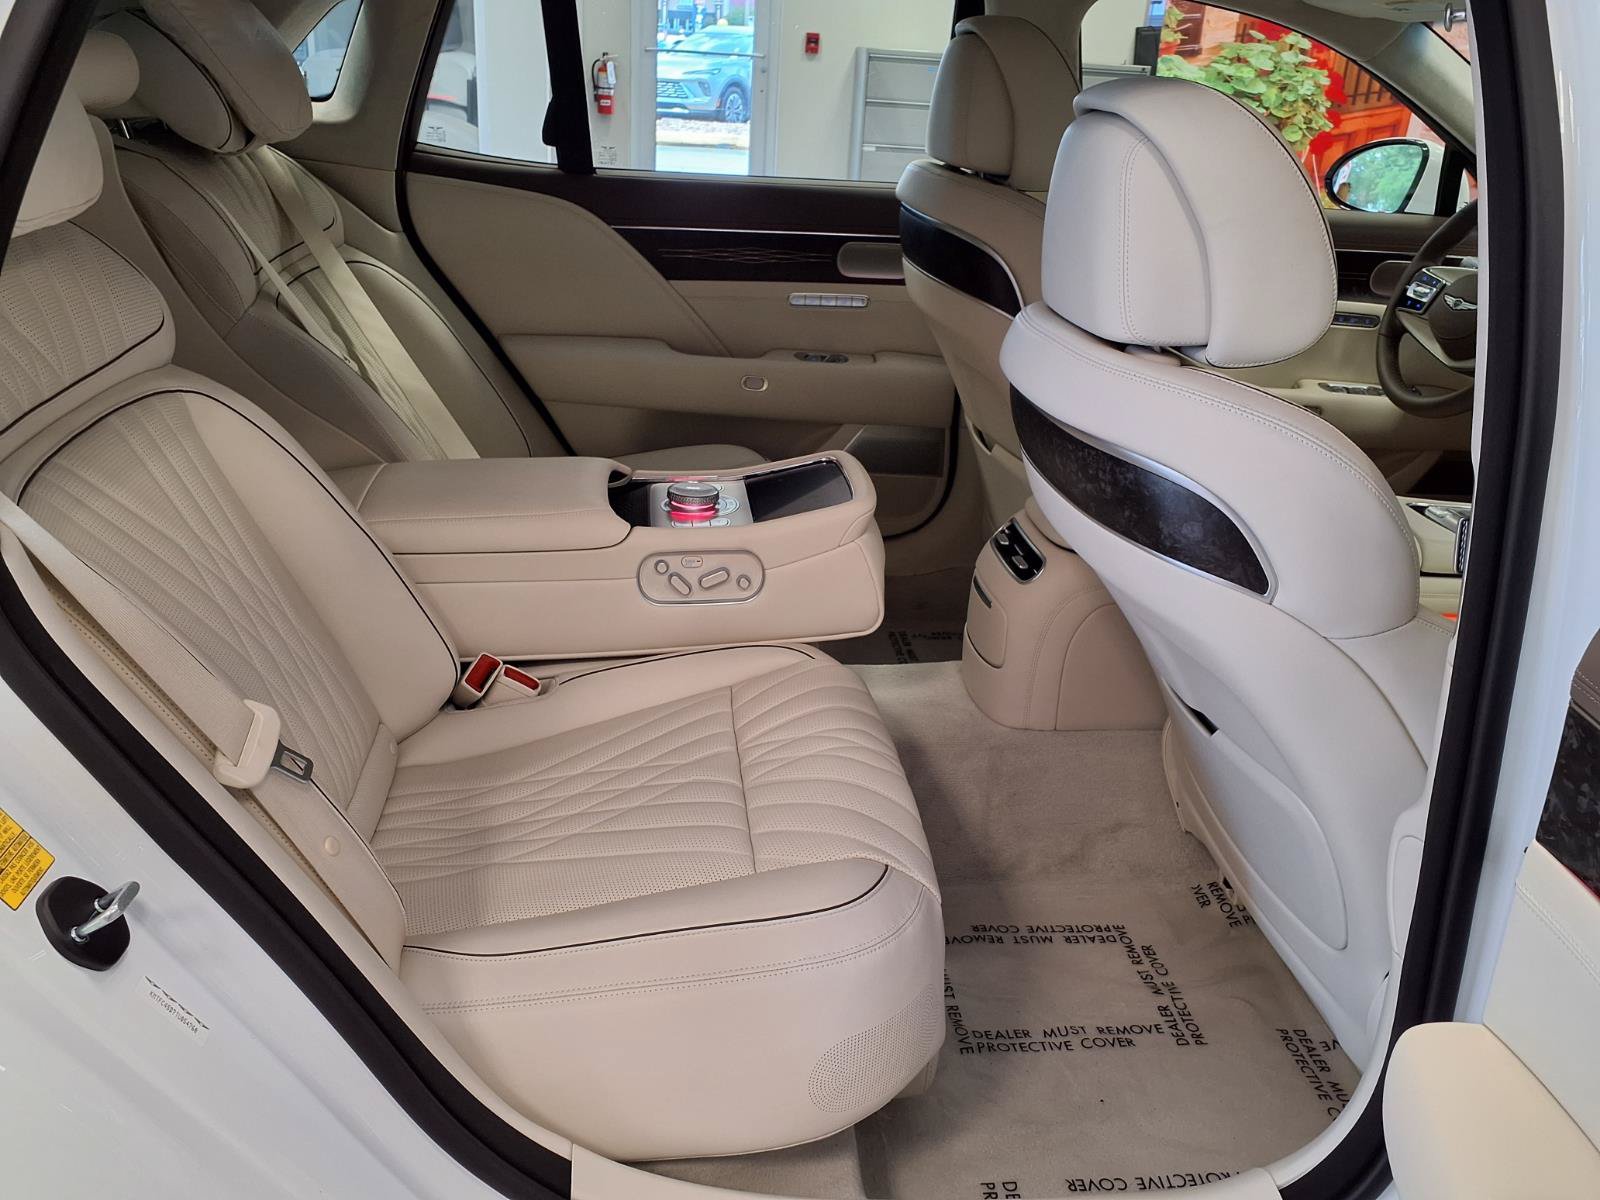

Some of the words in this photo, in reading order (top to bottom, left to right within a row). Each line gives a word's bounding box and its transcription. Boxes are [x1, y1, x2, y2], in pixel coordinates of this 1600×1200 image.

[1206, 881, 1242, 928] REMOVE
[971, 924, 1020, 933] COVER
[1013, 935, 1054, 944] MUST
[1025, 924, 1112, 933] PROTECTIVE
[1063, 934, 1118, 944] DEALER
[1112, 924, 1144, 965] REMOVE
[1141, 945, 1168, 976] COVER
[945, 1005, 974, 1055] REMOVE
[971, 1029, 1032, 1040] DEALER
[1043, 1025, 1088, 1038] MUST
[1096, 1024, 1165, 1036] REMOVE
[1157, 1004, 1190, 1046] DEALER
[976, 1041, 1074, 1053] PROTECTIVE
[1080, 1037, 1136, 1049] COVER
[1293, 1029, 1331, 1073] DEALER
[1275, 1028, 1333, 1101] PROTECTIVE
[1065, 1176, 1128, 1192] COVER
